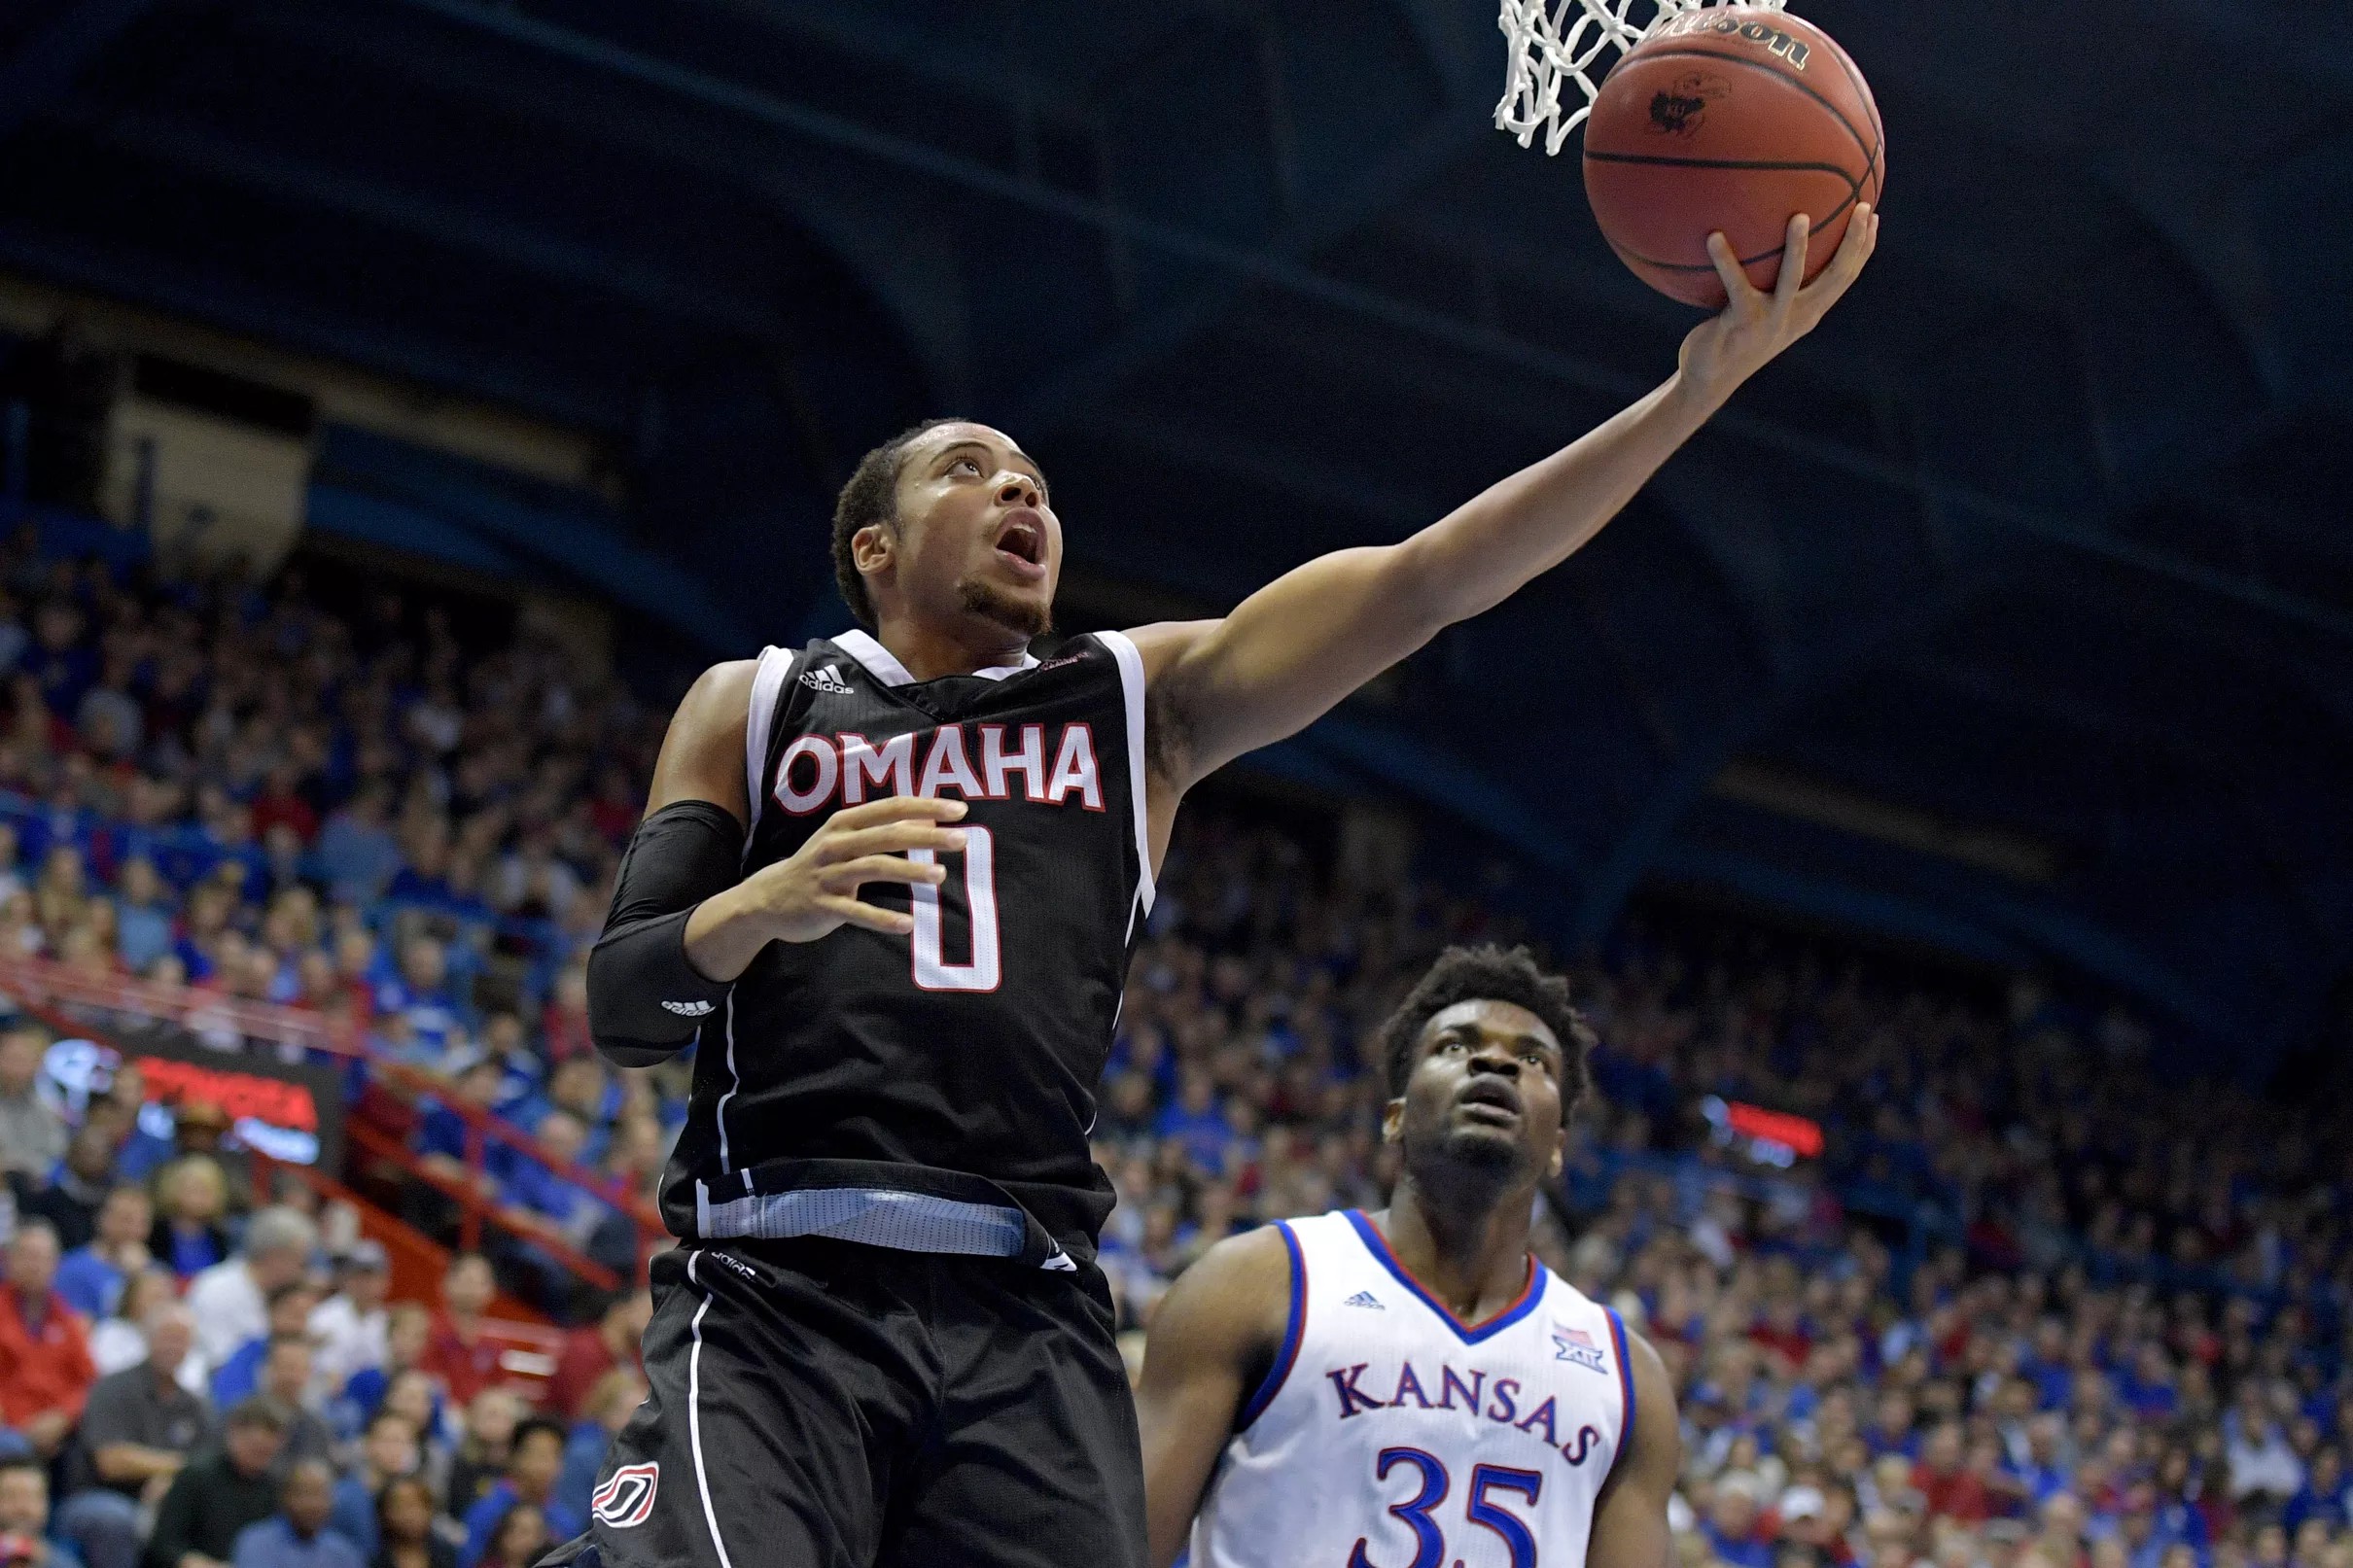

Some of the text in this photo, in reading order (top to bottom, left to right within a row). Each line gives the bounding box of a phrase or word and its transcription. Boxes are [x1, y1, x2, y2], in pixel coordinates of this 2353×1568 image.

[799, 675, 854, 694] adidas
[775, 722, 1106, 817] OMAHA
[906, 823, 1001, 993] 0
[1326, 1360, 1599, 1466] KANSAS
[1347, 1446, 1542, 1568] 35
